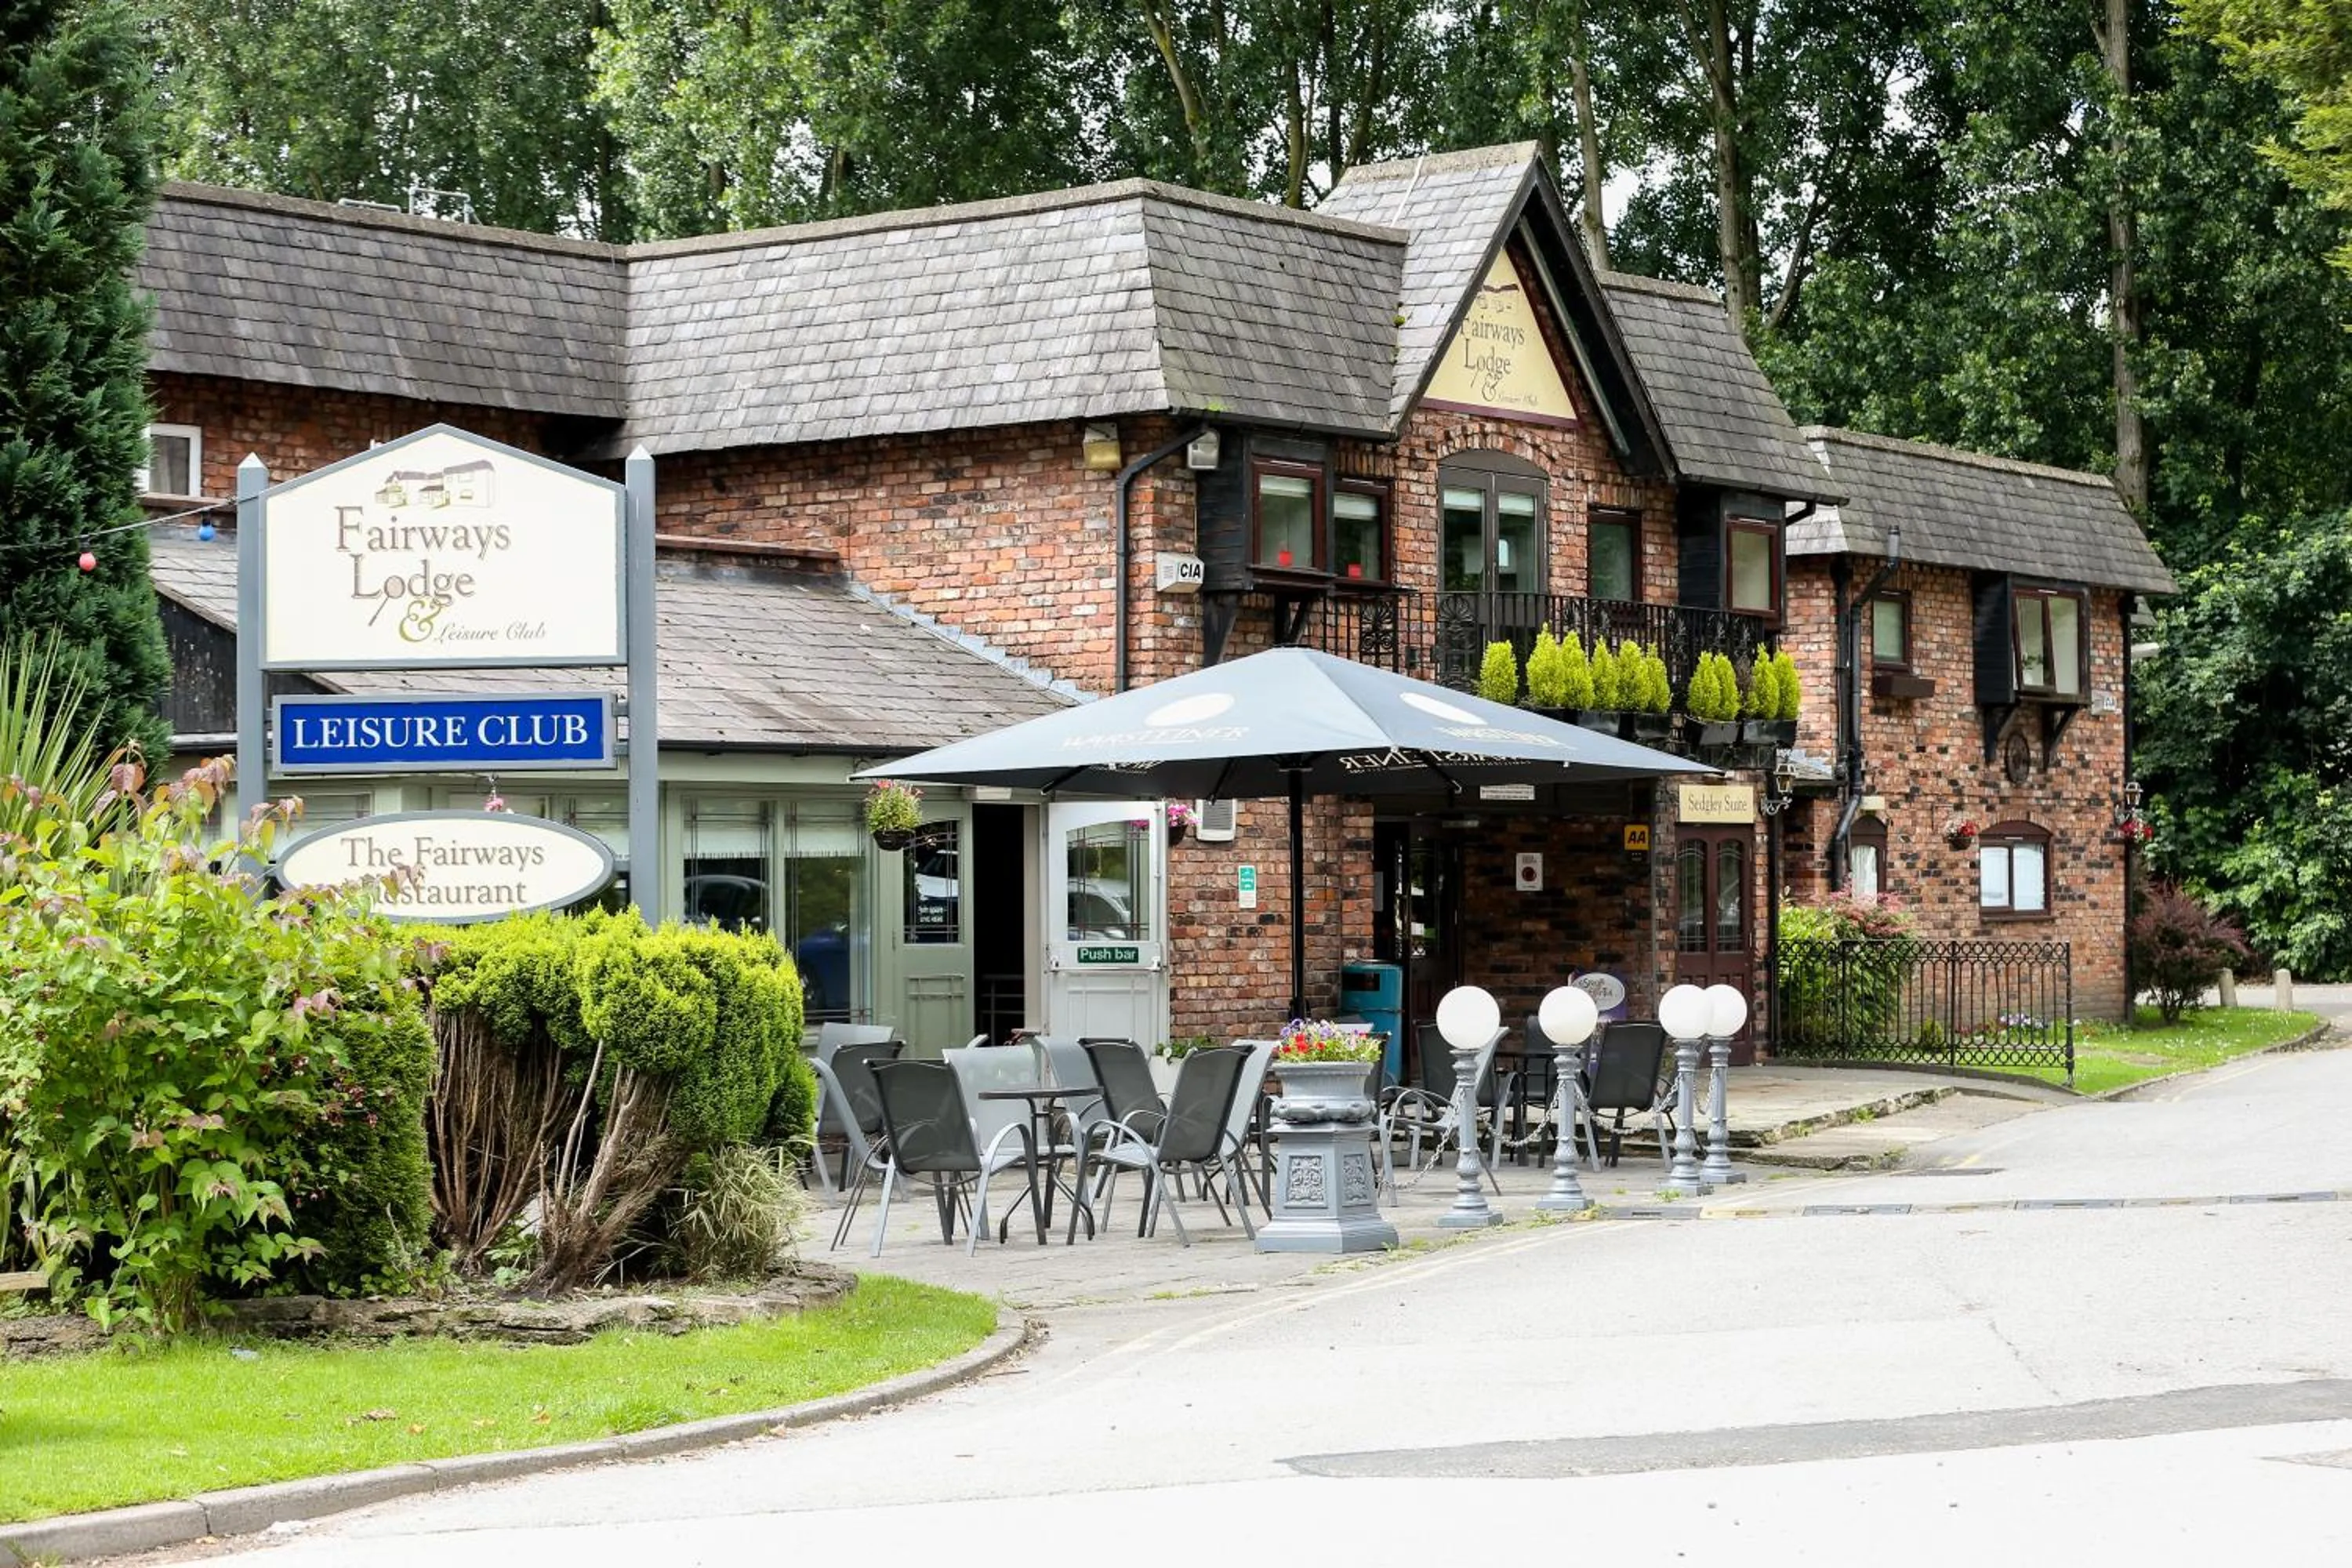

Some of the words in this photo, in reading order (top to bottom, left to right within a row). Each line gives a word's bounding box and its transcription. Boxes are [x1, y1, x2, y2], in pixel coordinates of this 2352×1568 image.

[1464, 338, 1512, 381] Lodge
[334, 506, 511, 560] Fairways
[350, 553, 476, 608] Lodge
[1180, 562, 1201, 579] CIA
[398, 599, 444, 642] &
[434, 621, 499, 644] Leisure
[292, 716, 469, 750] LEISURE
[477, 713, 590, 747] CLUB
[1687, 793, 1722, 816] Sedgley
[339, 837, 403, 867] The
[414, 837, 546, 873] Fairways
[1627, 830, 1646, 844] AA
[1080, 947, 1112, 960] Push
[1114, 947, 1136, 960] bar
